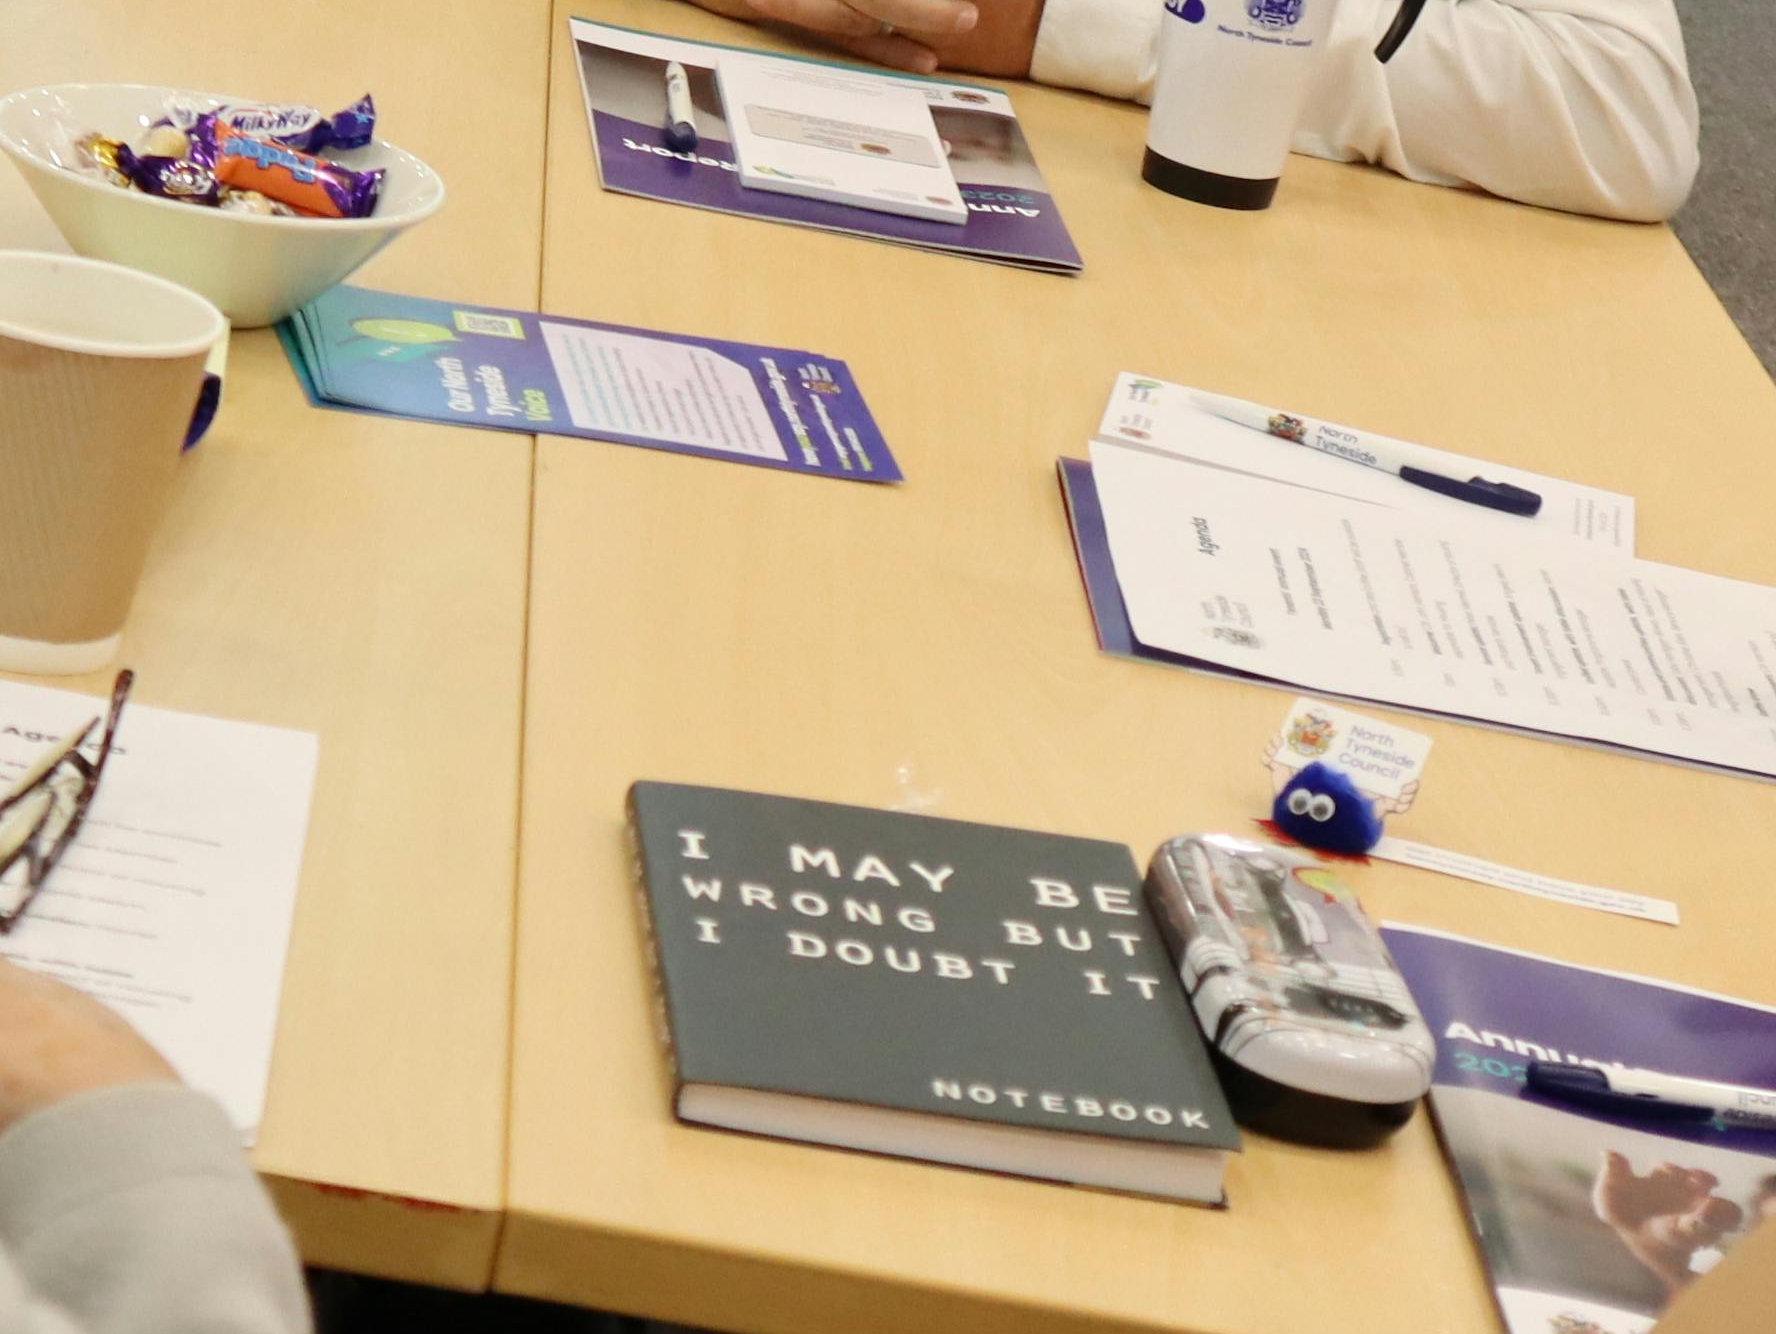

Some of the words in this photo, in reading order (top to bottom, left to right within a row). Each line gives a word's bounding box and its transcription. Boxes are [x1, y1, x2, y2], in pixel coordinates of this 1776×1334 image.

[434, 356, 468, 387] North
[447, 385, 475, 413] Our
[475, 364, 522, 417] Tyneside
[520, 388, 553, 422] Voice
[1314, 434, 1377, 465] Tyneside
[1317, 424, 1359, 444] North
[1186, 513, 1224, 559] Agenda
[1351, 725, 1394, 747] North
[1339, 752, 1401, 780] Council
[1345, 737, 1416, 768] Tyneside
[677, 830, 710, 860] I
[788, 844, 954, 894] MAY
[1031, 876, 1140, 917] BE
[682, 875, 936, 934] WRONG
[1003, 920, 1142, 958] BUT
[694, 918, 721, 944] I
[786, 930, 1016, 986] DOUBT
[1085, 970, 1160, 1001] IT
[930, 1077, 1210, 1130] NOTEBOOK
